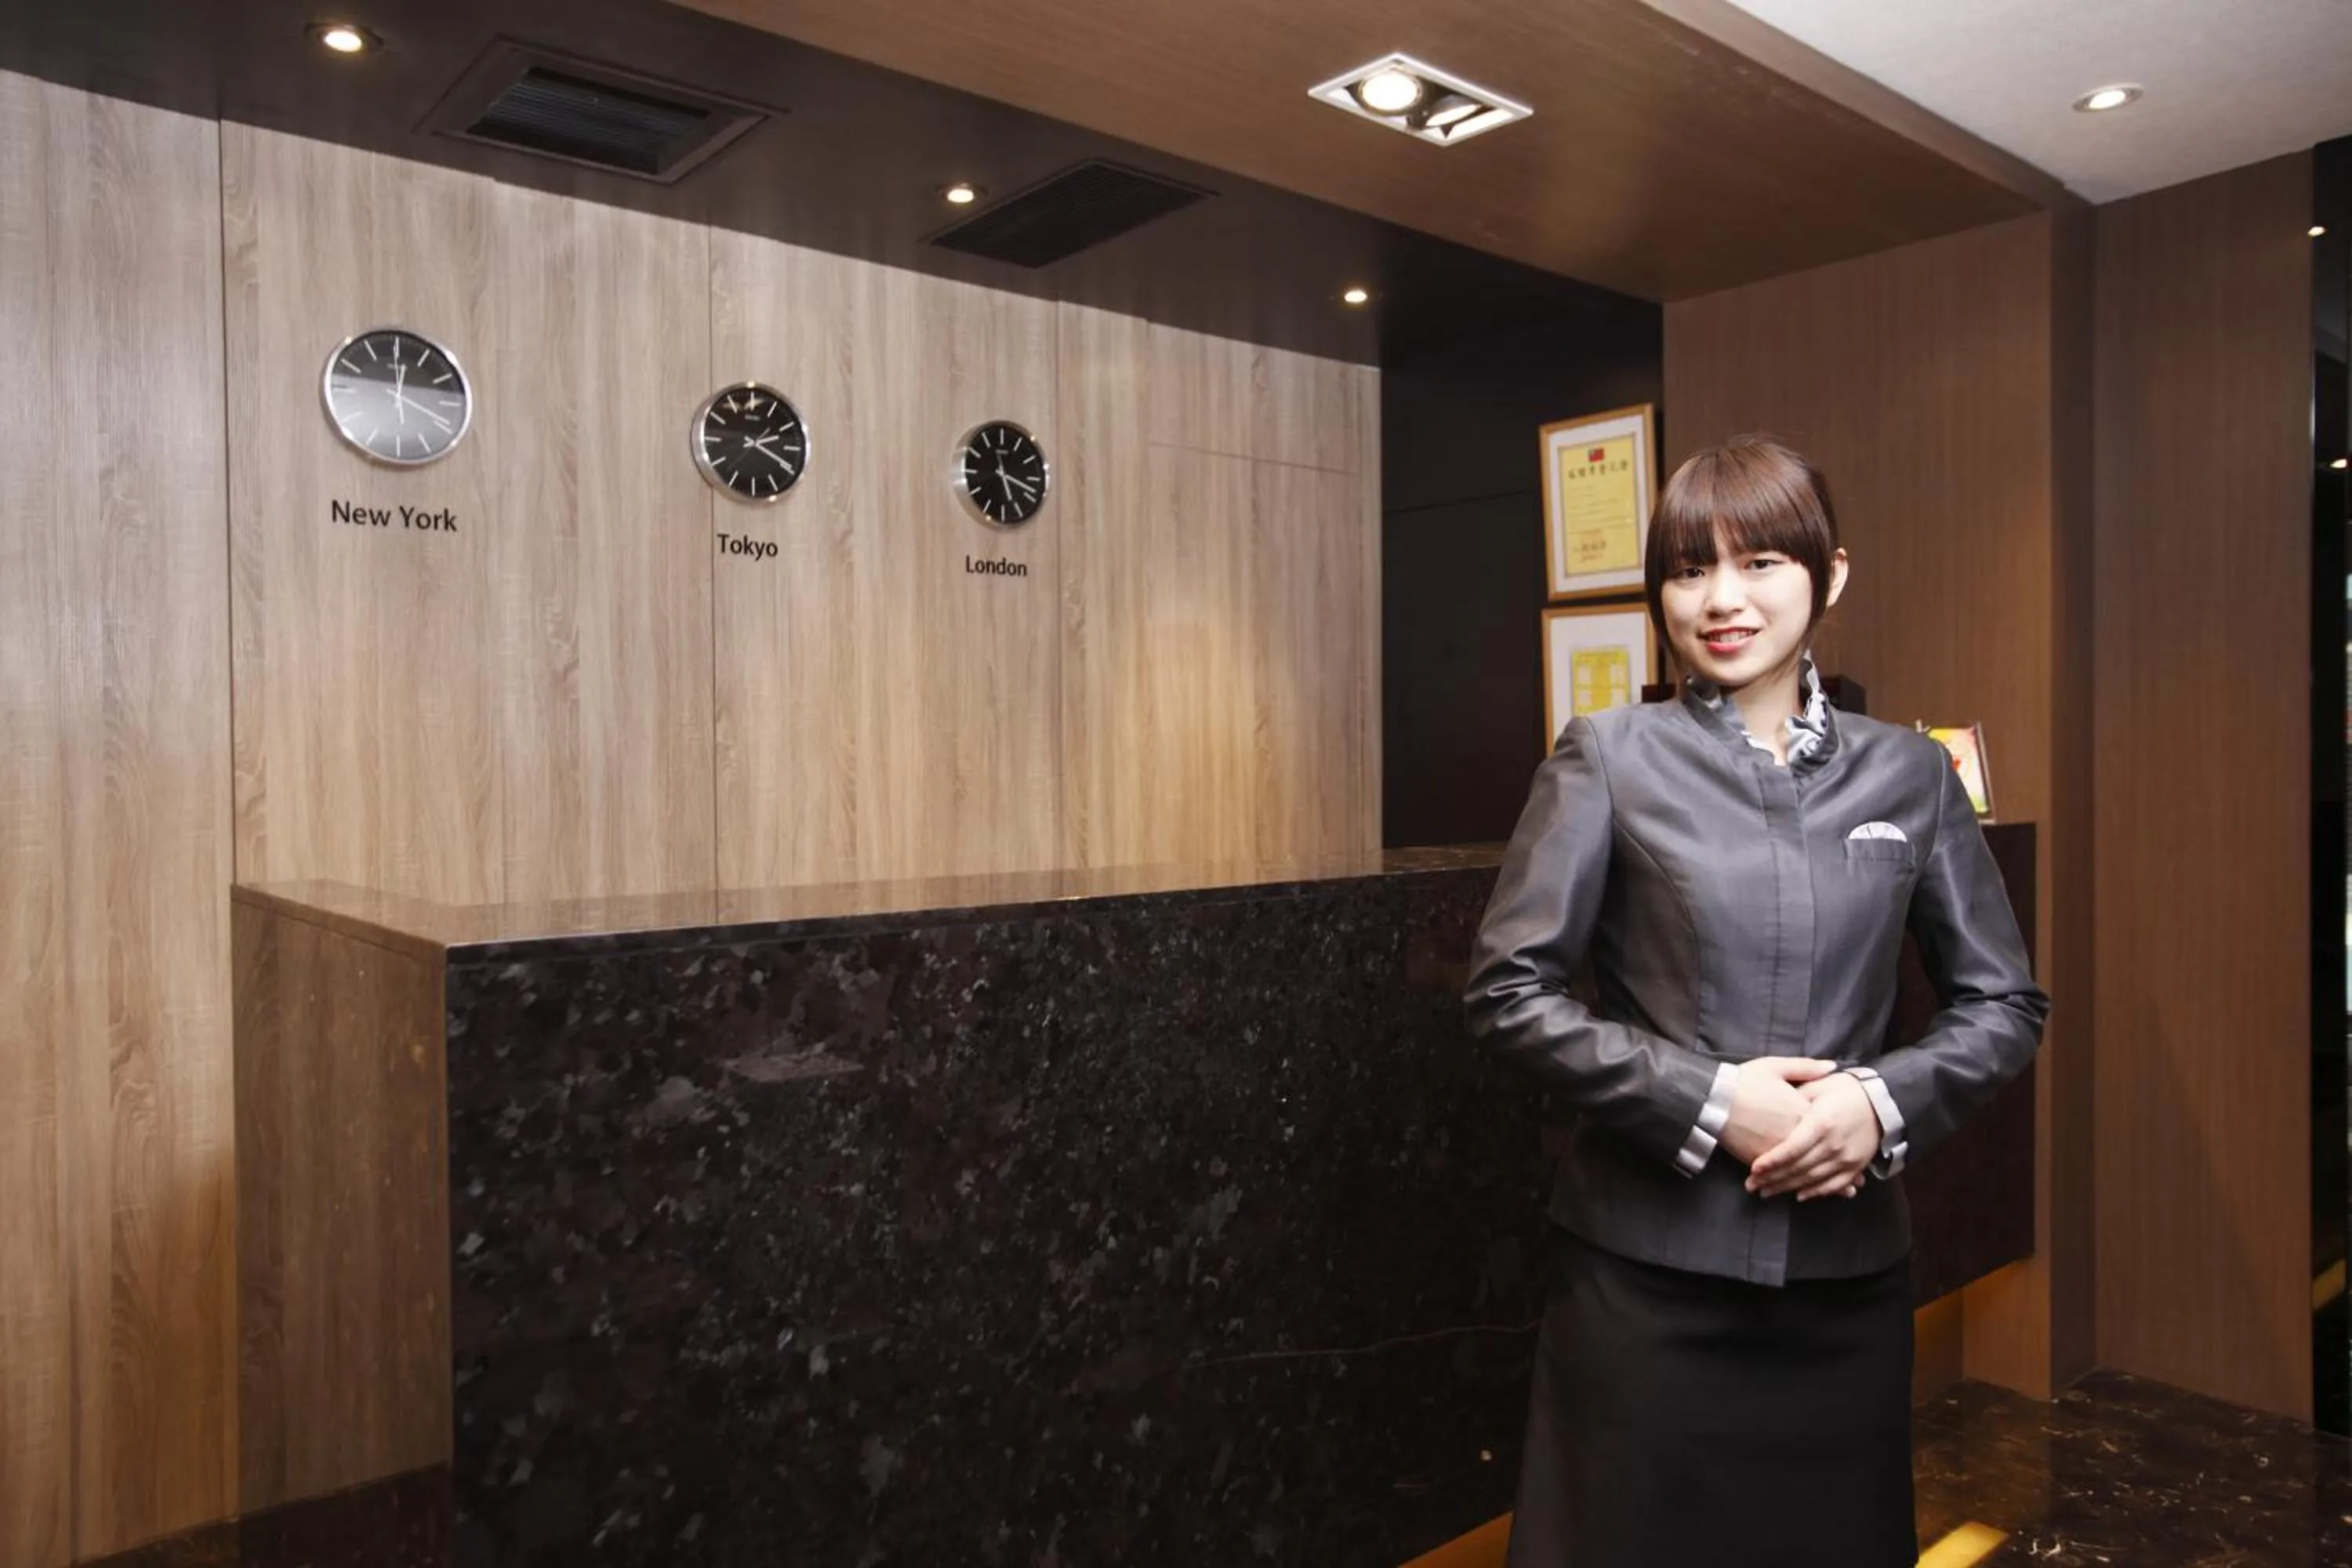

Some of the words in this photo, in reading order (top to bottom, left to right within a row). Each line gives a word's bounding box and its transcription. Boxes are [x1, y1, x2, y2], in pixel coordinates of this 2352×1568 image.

[332, 499, 390, 527] New
[399, 505, 457, 532] York
[717, 533, 779, 561] Tokyo
[966, 554, 1028, 577] London
